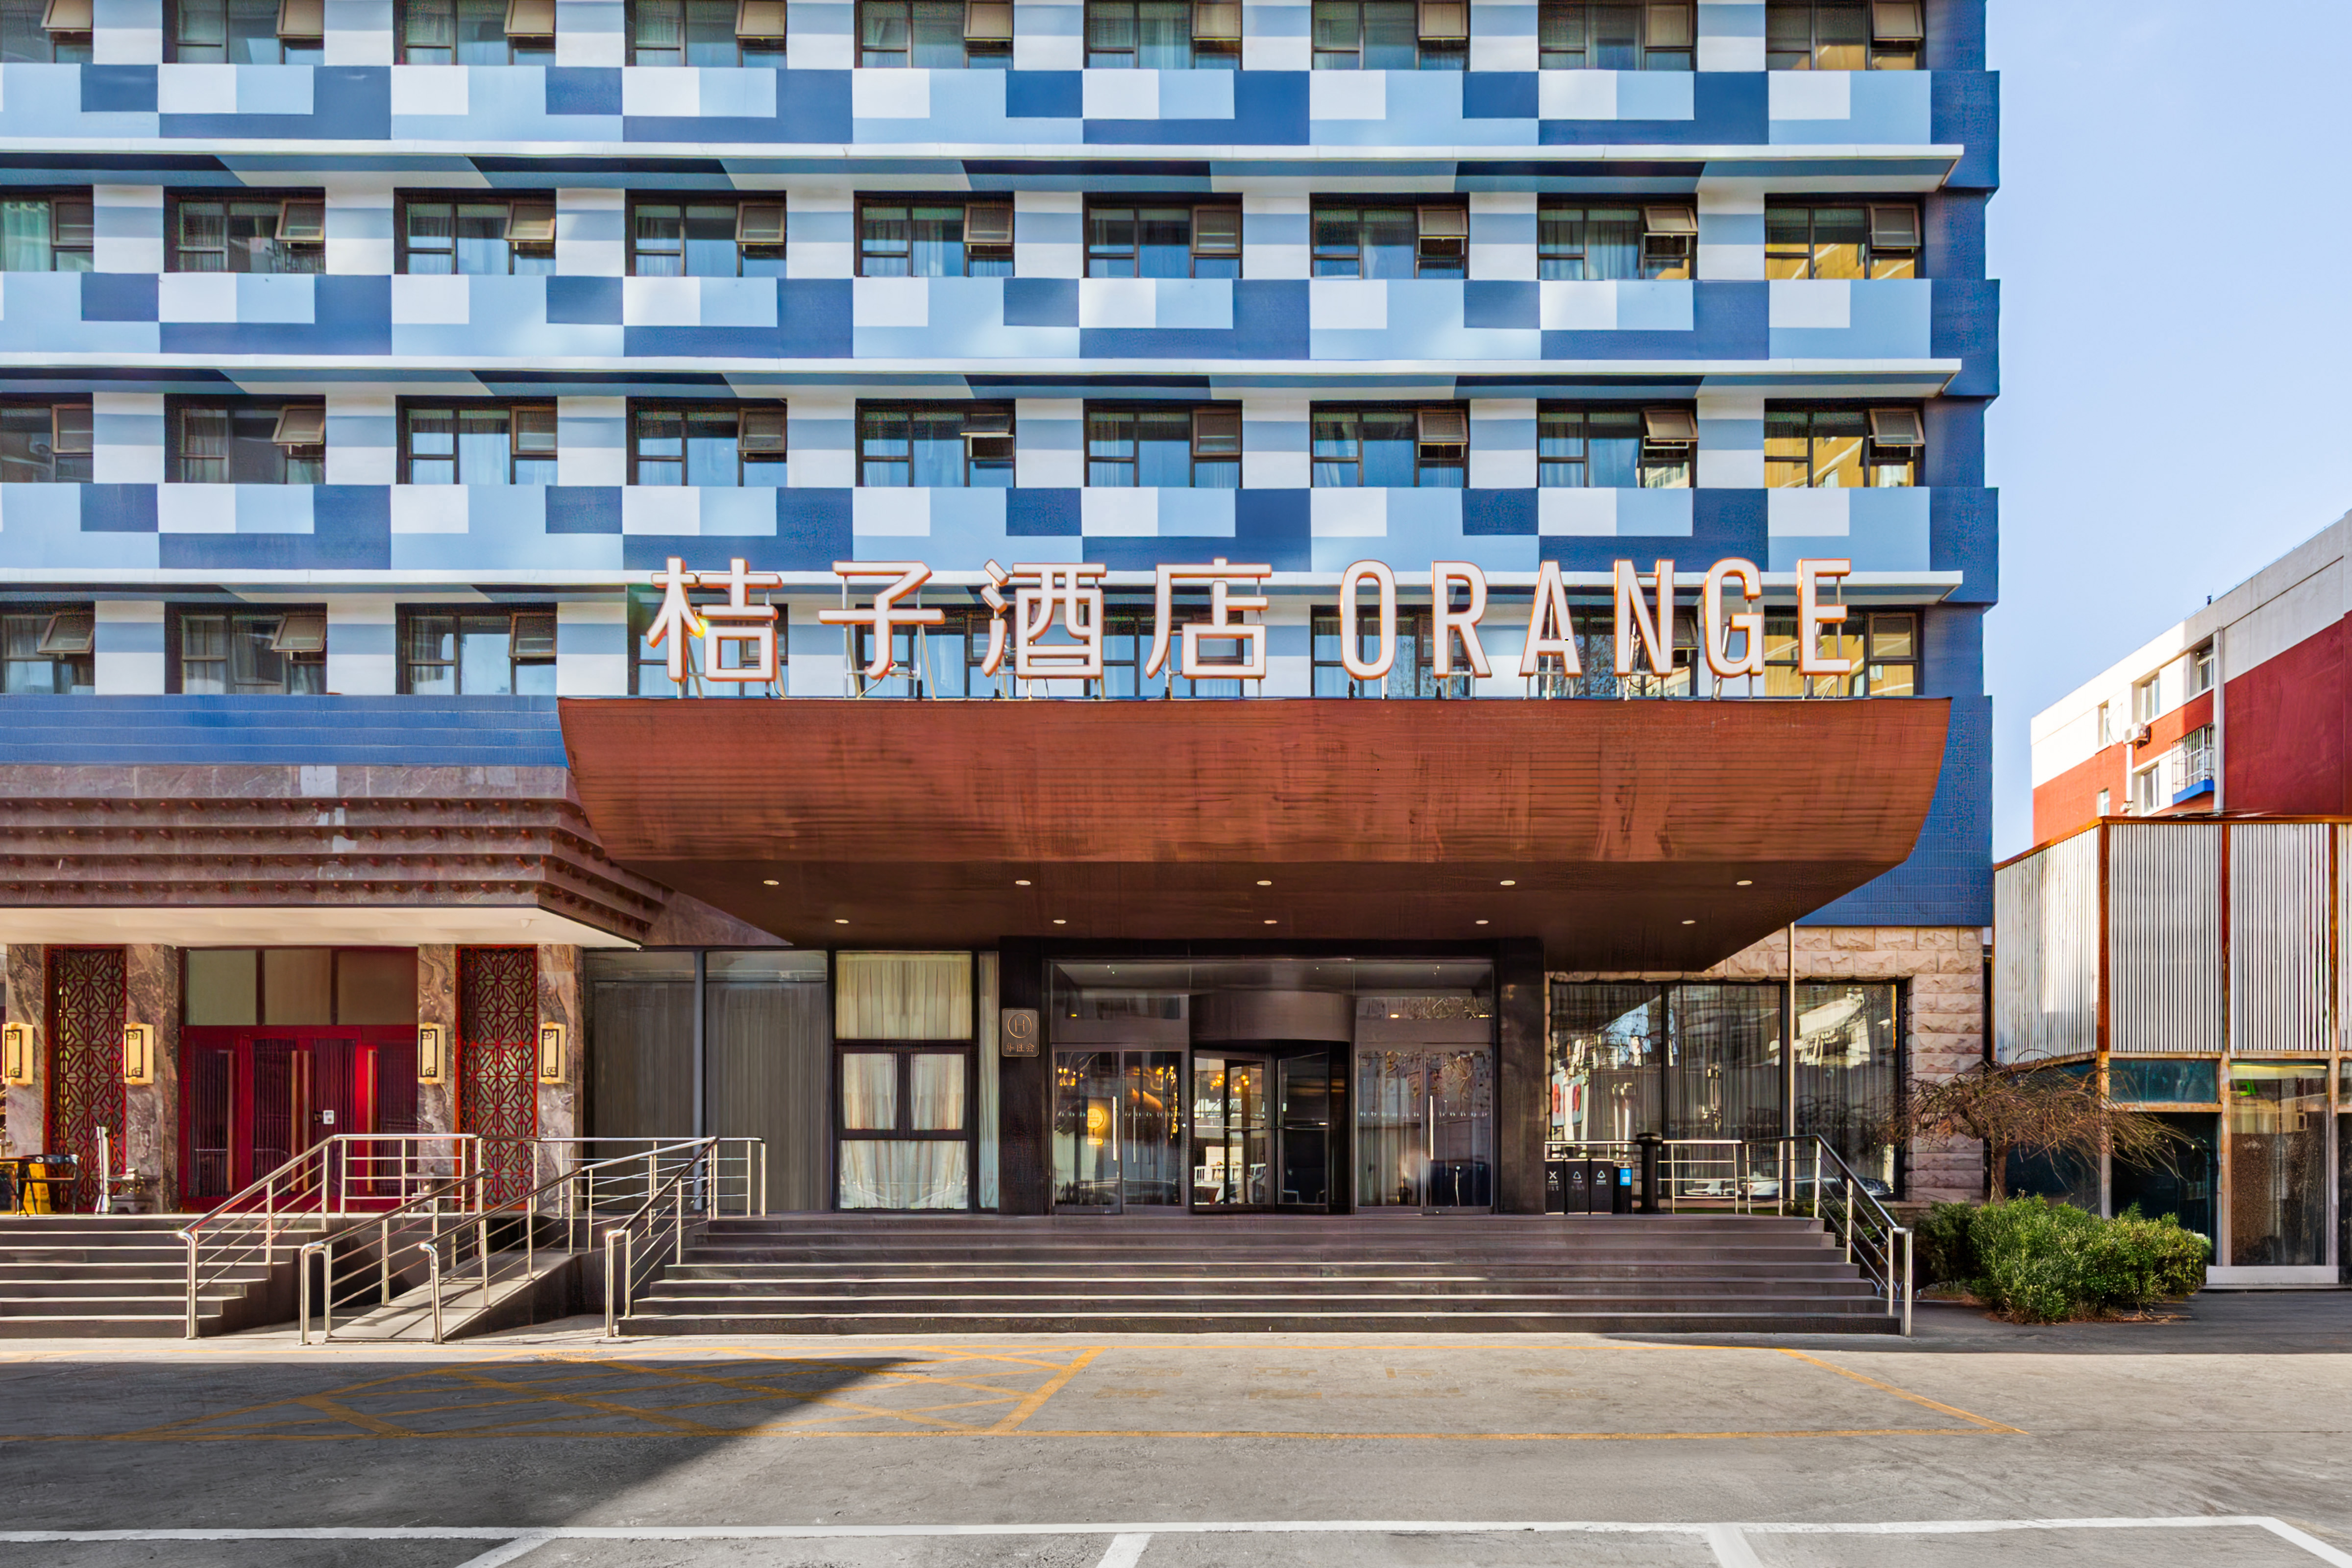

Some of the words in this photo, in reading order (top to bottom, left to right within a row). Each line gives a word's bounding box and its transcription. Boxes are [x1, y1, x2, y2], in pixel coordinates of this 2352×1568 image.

[647, 557, 1272, 681] 桔子酒店
[1339, 557, 1851, 680] ORANGE
[1006, 1042, 1035, 1053] 华住会
[1015, 1019, 1025, 1032] H
